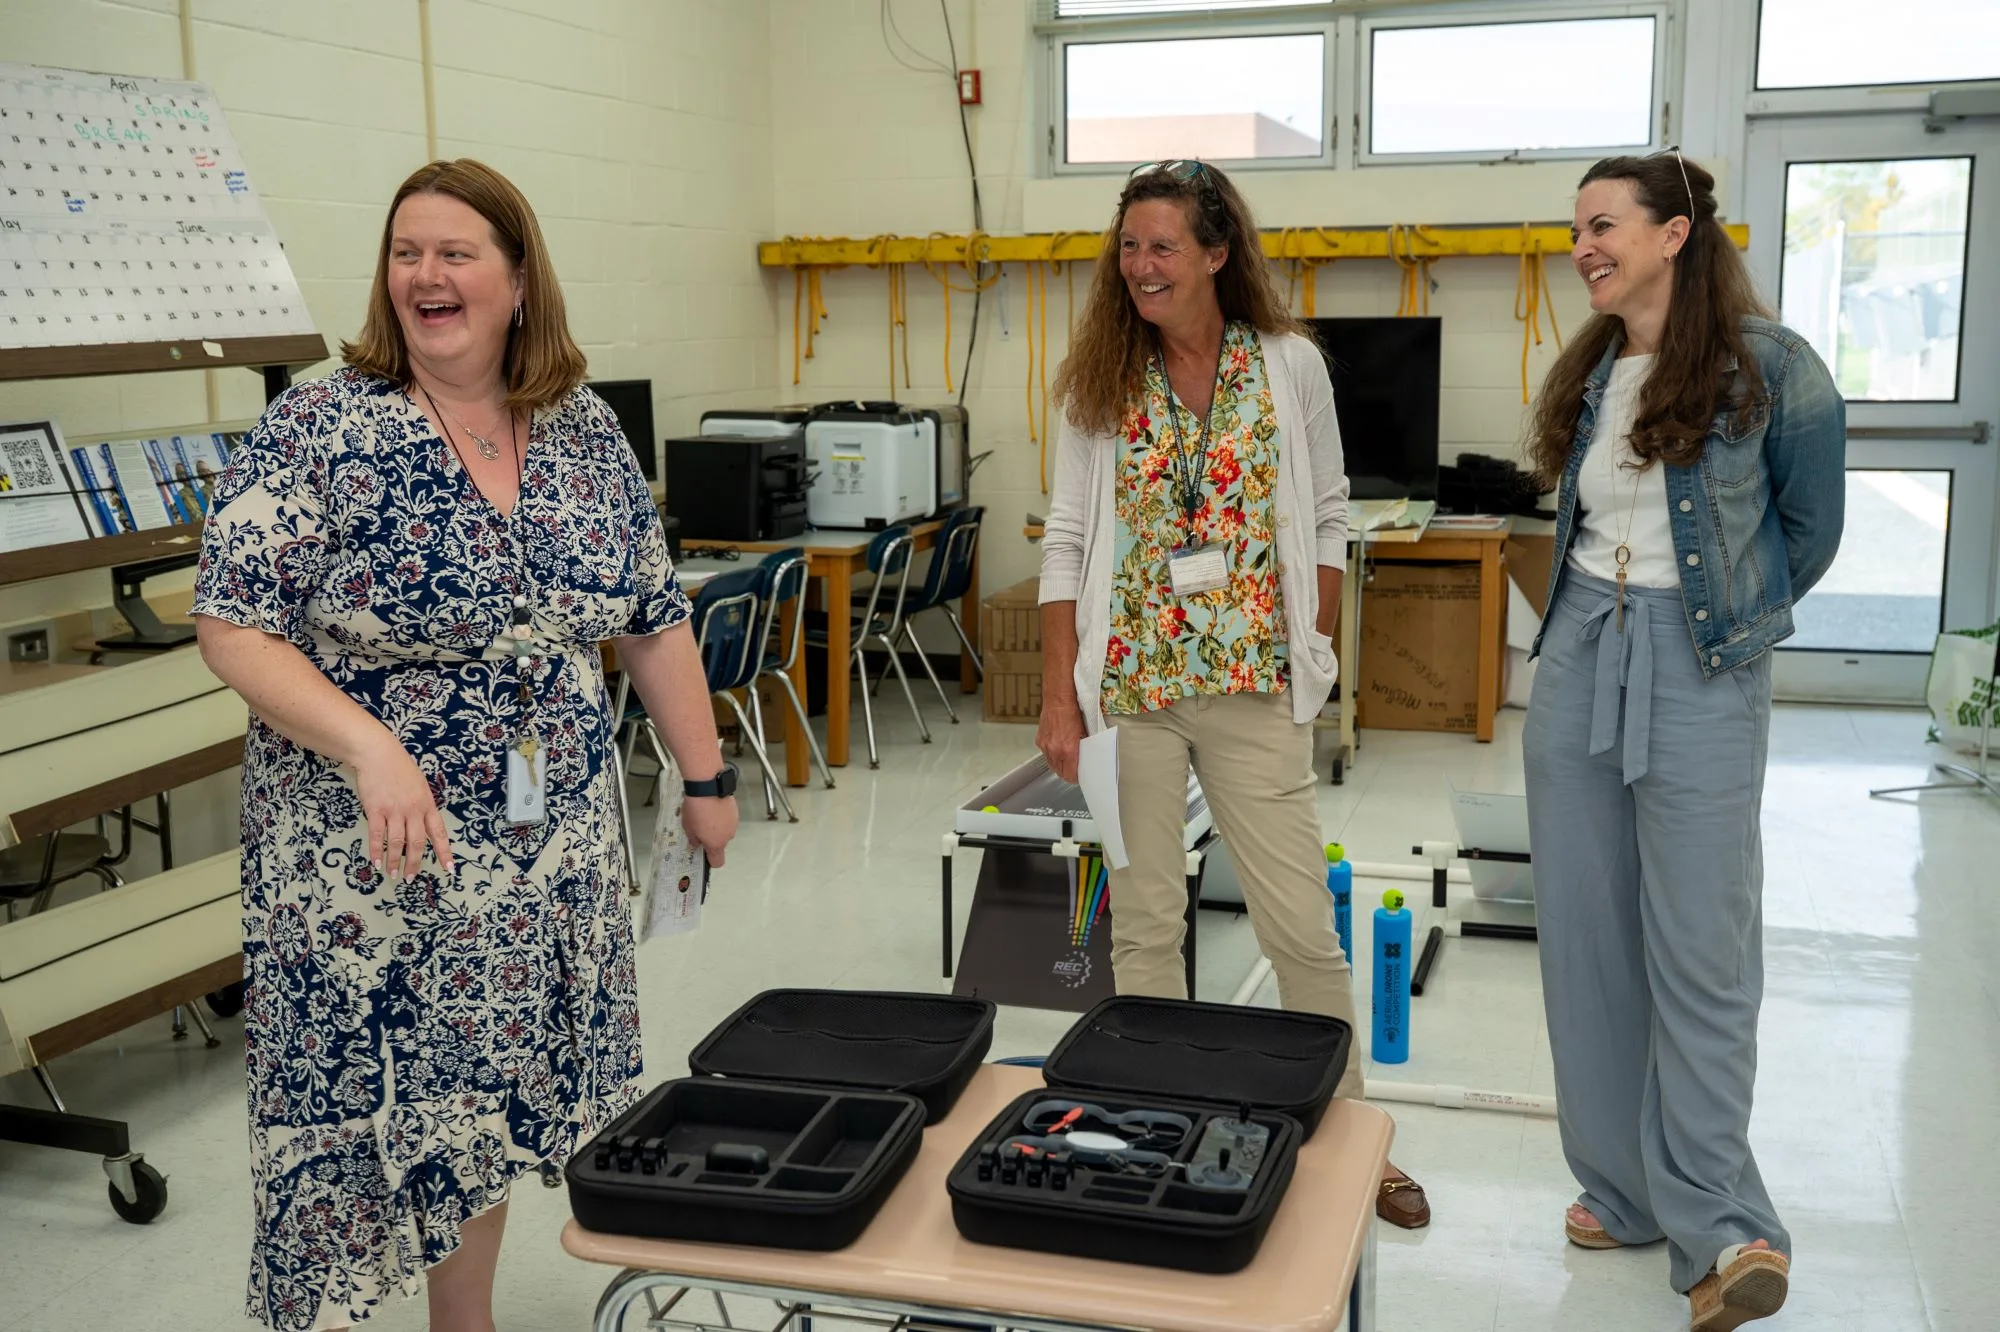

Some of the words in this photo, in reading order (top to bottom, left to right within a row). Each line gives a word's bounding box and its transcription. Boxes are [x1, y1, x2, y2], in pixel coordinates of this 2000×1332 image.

[110, 77, 139, 93] April
[135, 104, 209, 122] SPRING
[74, 123, 152, 142] BREAK
[175, 221, 206, 235] June
[1053, 961, 1083, 972] REC
[1392, 963, 1401, 1027] COMPETITION
